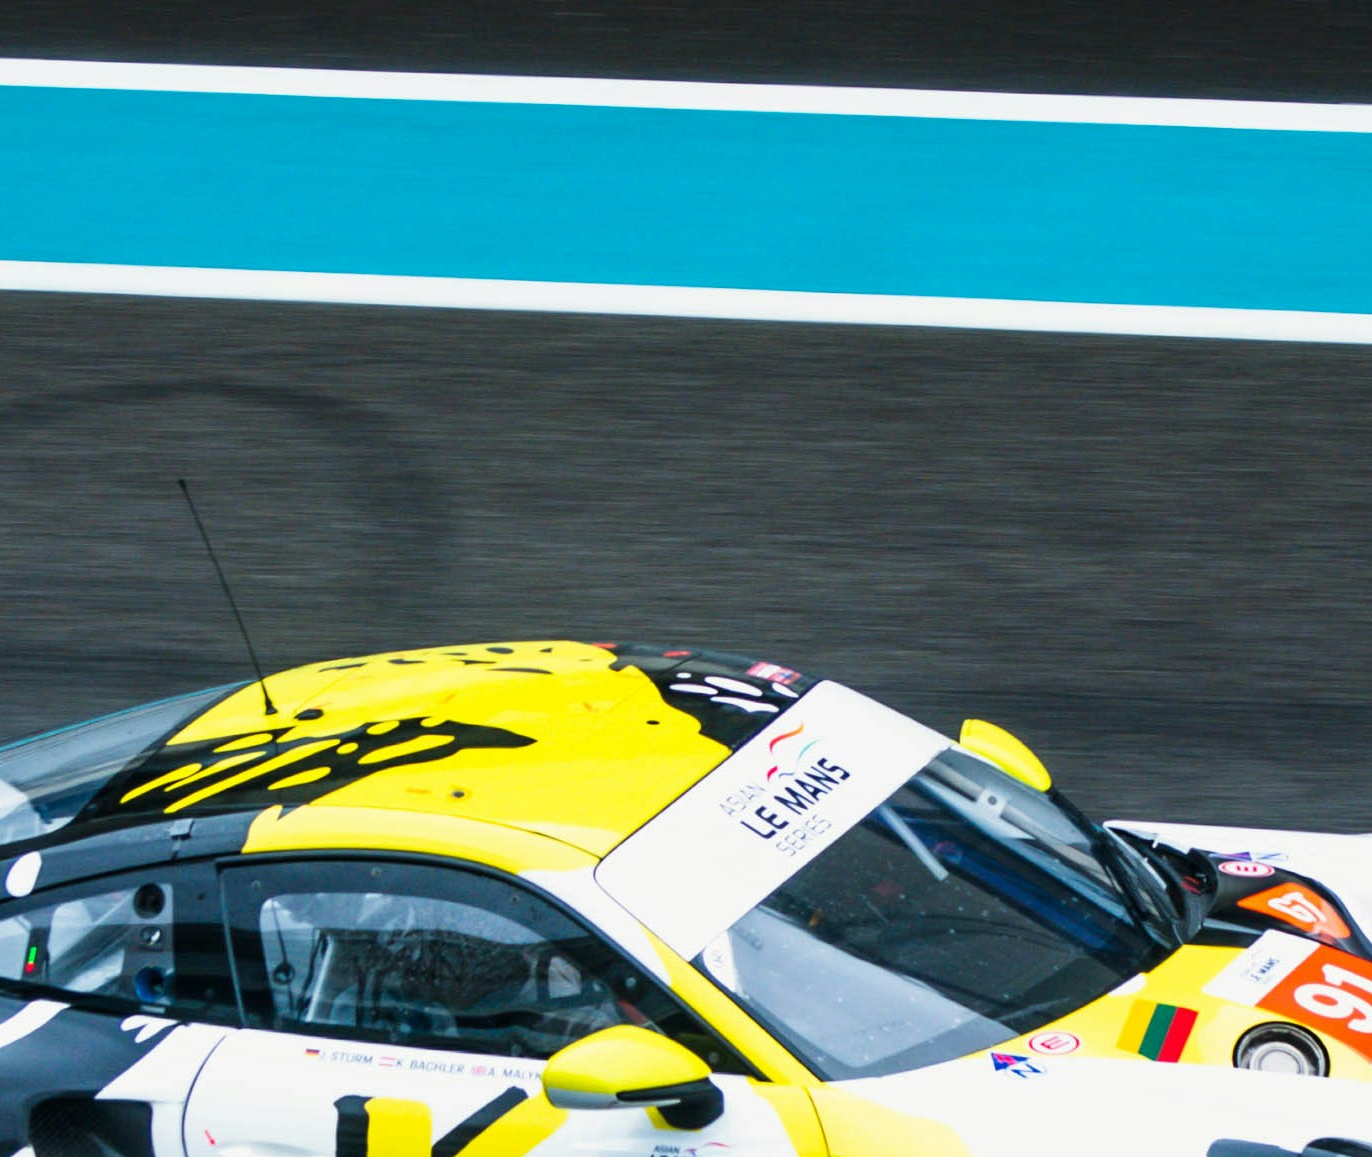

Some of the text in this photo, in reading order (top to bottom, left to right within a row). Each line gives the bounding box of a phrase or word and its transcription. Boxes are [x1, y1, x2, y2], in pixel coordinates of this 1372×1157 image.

[719, 783, 766, 817] ASIAN
[740, 757, 851, 839] LE MANS
[776, 813, 832, 857] SERIES
[1267, 890, 1328, 924] GT
